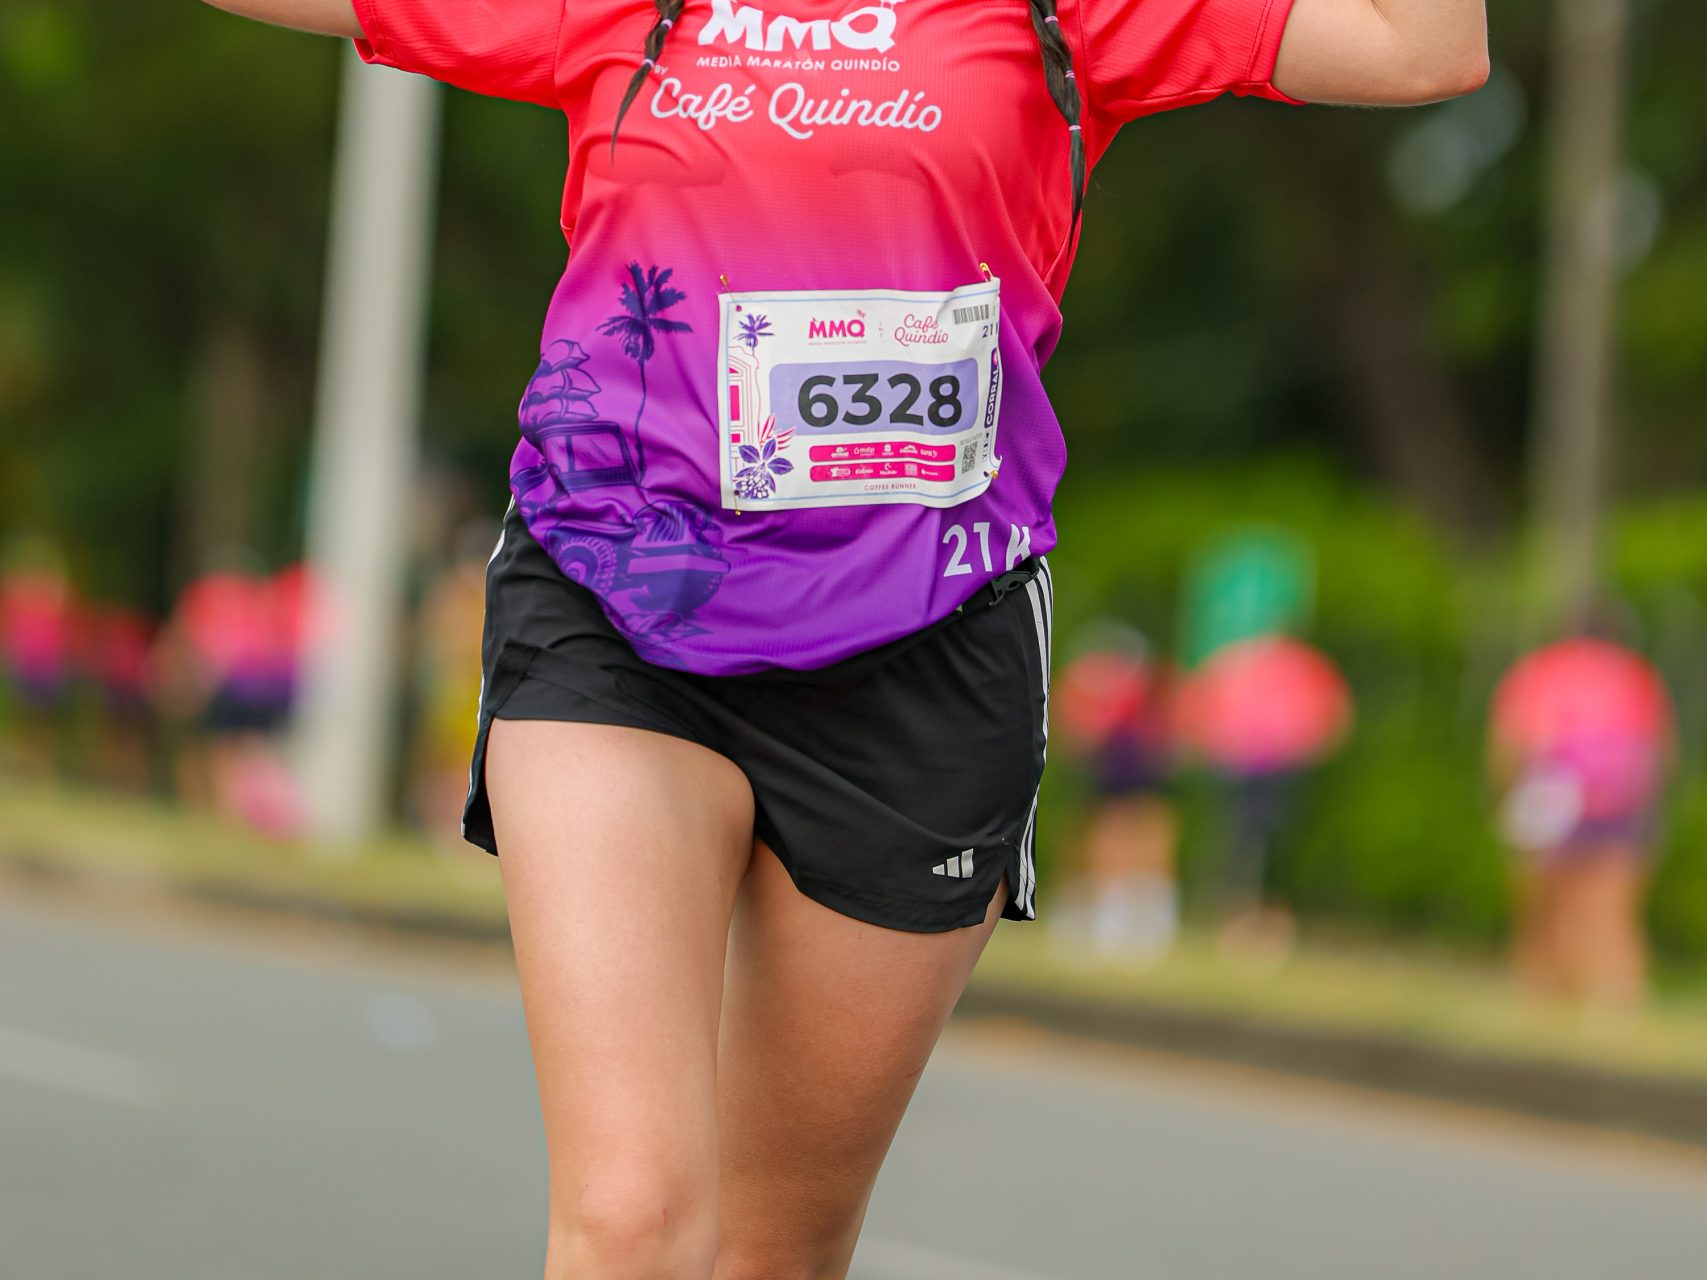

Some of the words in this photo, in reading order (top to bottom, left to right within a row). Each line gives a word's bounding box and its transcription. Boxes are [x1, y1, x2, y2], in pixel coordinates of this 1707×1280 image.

[696, 54, 742, 68] MEDIA
[747, 55, 825, 71] MARATÓN
[830, 56, 901, 72] QUINDÍO
[650, 77, 757, 131] Café
[768, 81, 943, 140] Quindío
[808, 318, 865, 339] MMQ
[894, 326, 949, 347] Quindío
[982, 323, 994, 338] 21
[797, 373, 962, 428] 6328
[986, 368, 1000, 425] CORRAL
[864, 483, 889, 491] COFFEE
[890, 482, 917, 490] RUNNER
[942, 522, 993, 577] 21
